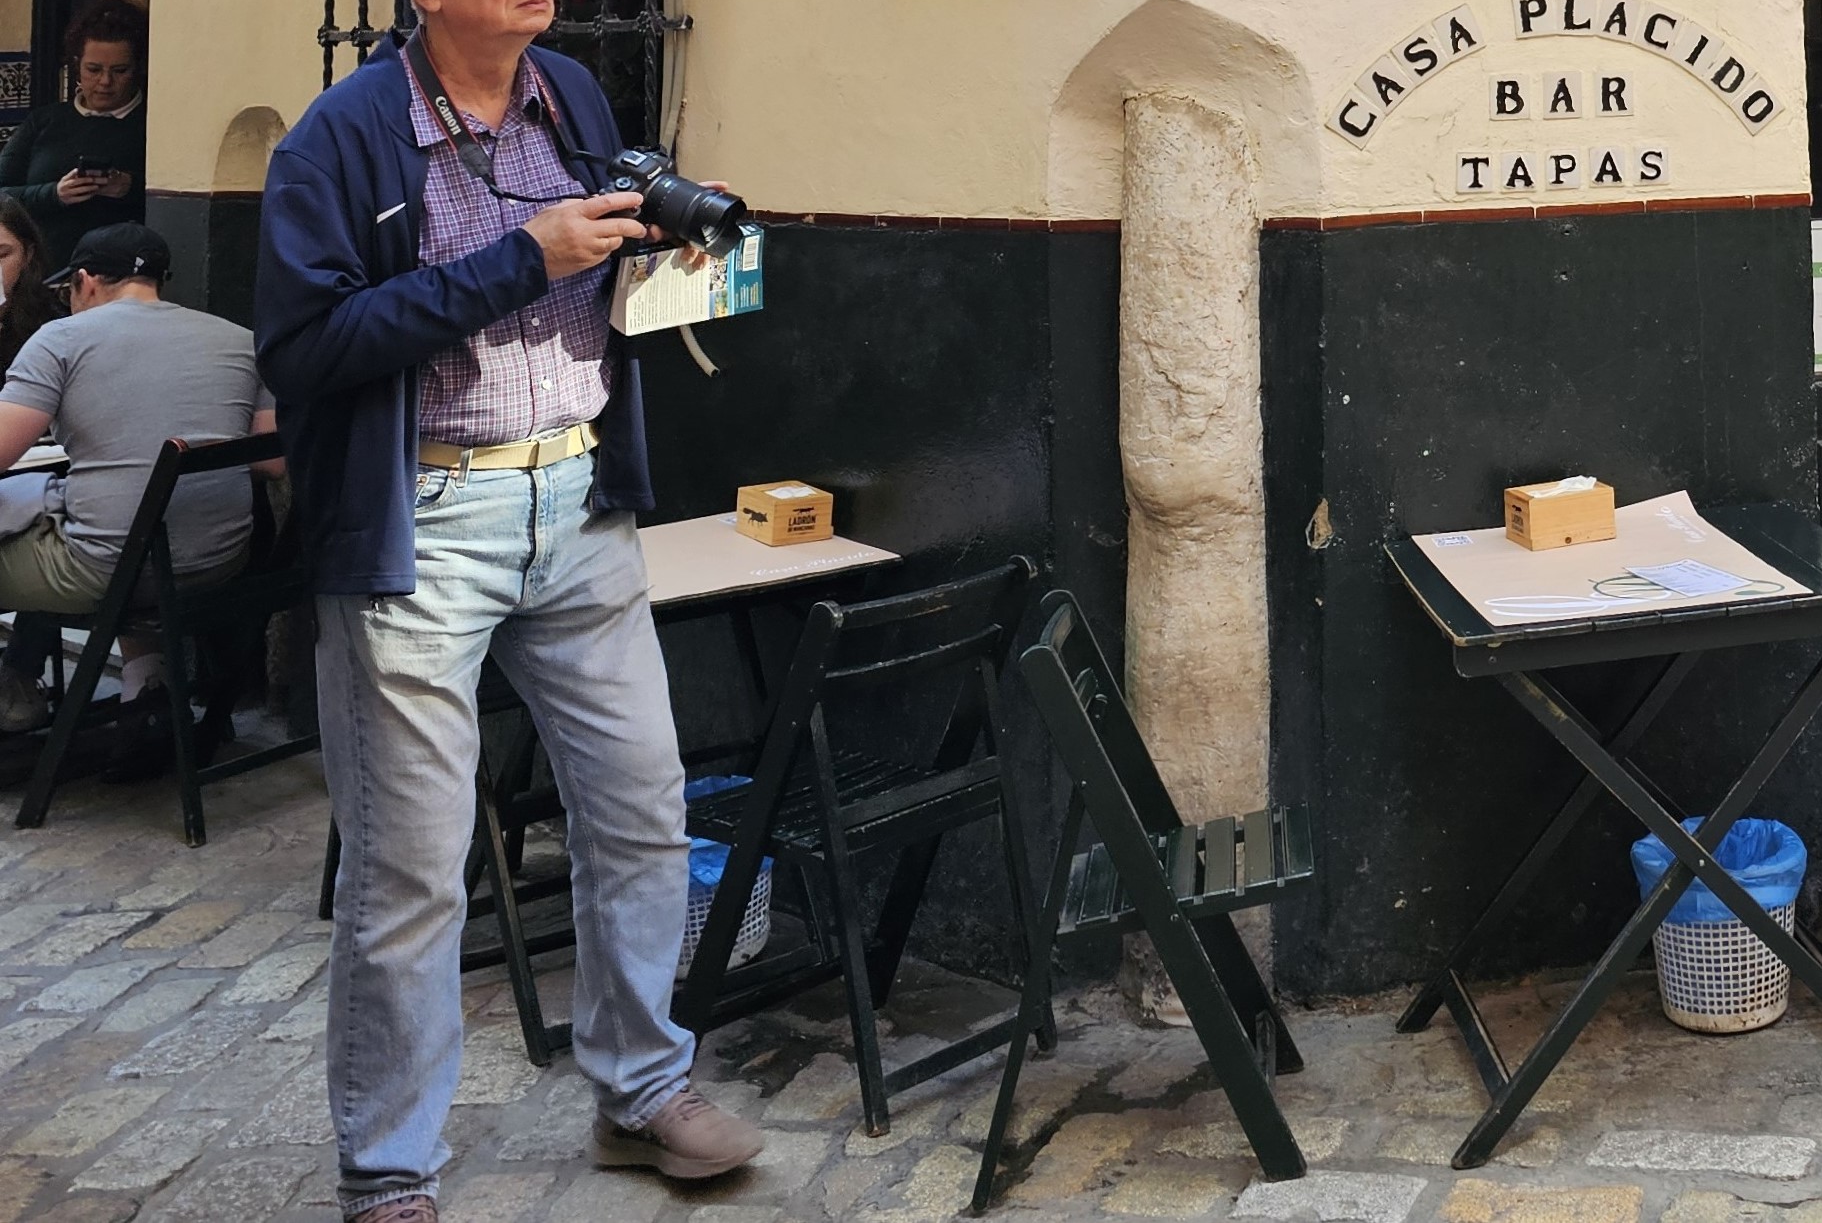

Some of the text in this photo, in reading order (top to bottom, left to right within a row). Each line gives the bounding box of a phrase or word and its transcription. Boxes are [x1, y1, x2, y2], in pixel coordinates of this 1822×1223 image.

[1335, 13, 1475, 138] CASA
[1495, 76, 1628, 115] BAR
[1460, 150, 1664, 189] TAPAS
